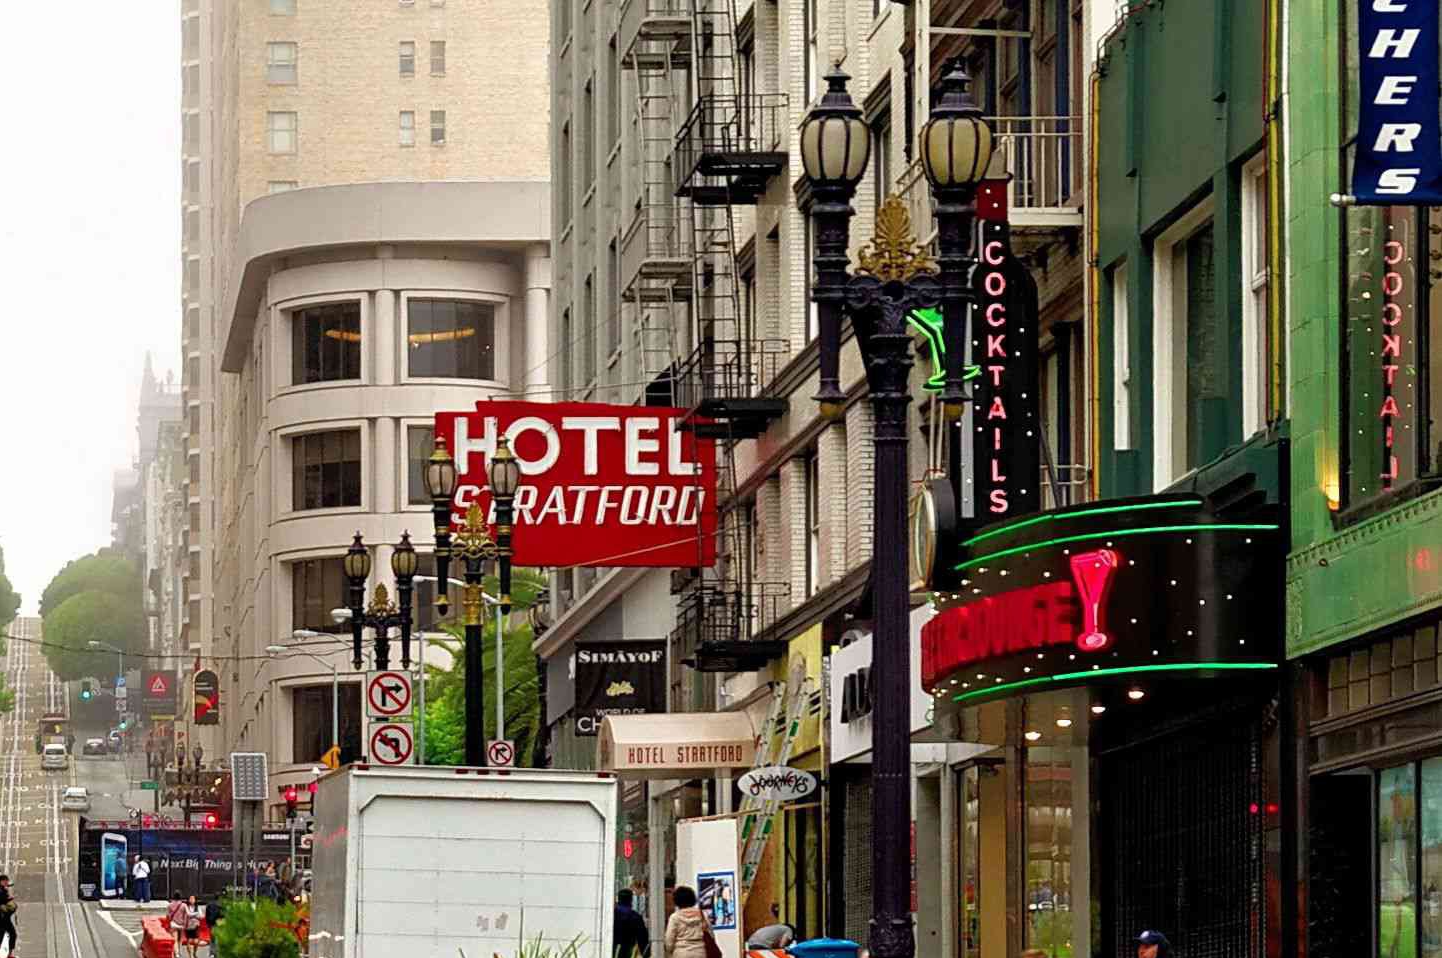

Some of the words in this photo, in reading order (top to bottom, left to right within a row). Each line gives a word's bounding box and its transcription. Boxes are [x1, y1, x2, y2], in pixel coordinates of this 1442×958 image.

[985, 240, 1008, 513] COCKTAILS
[454, 416, 703, 476] HOTEL
[628, 747, 665, 763] HOTEL
